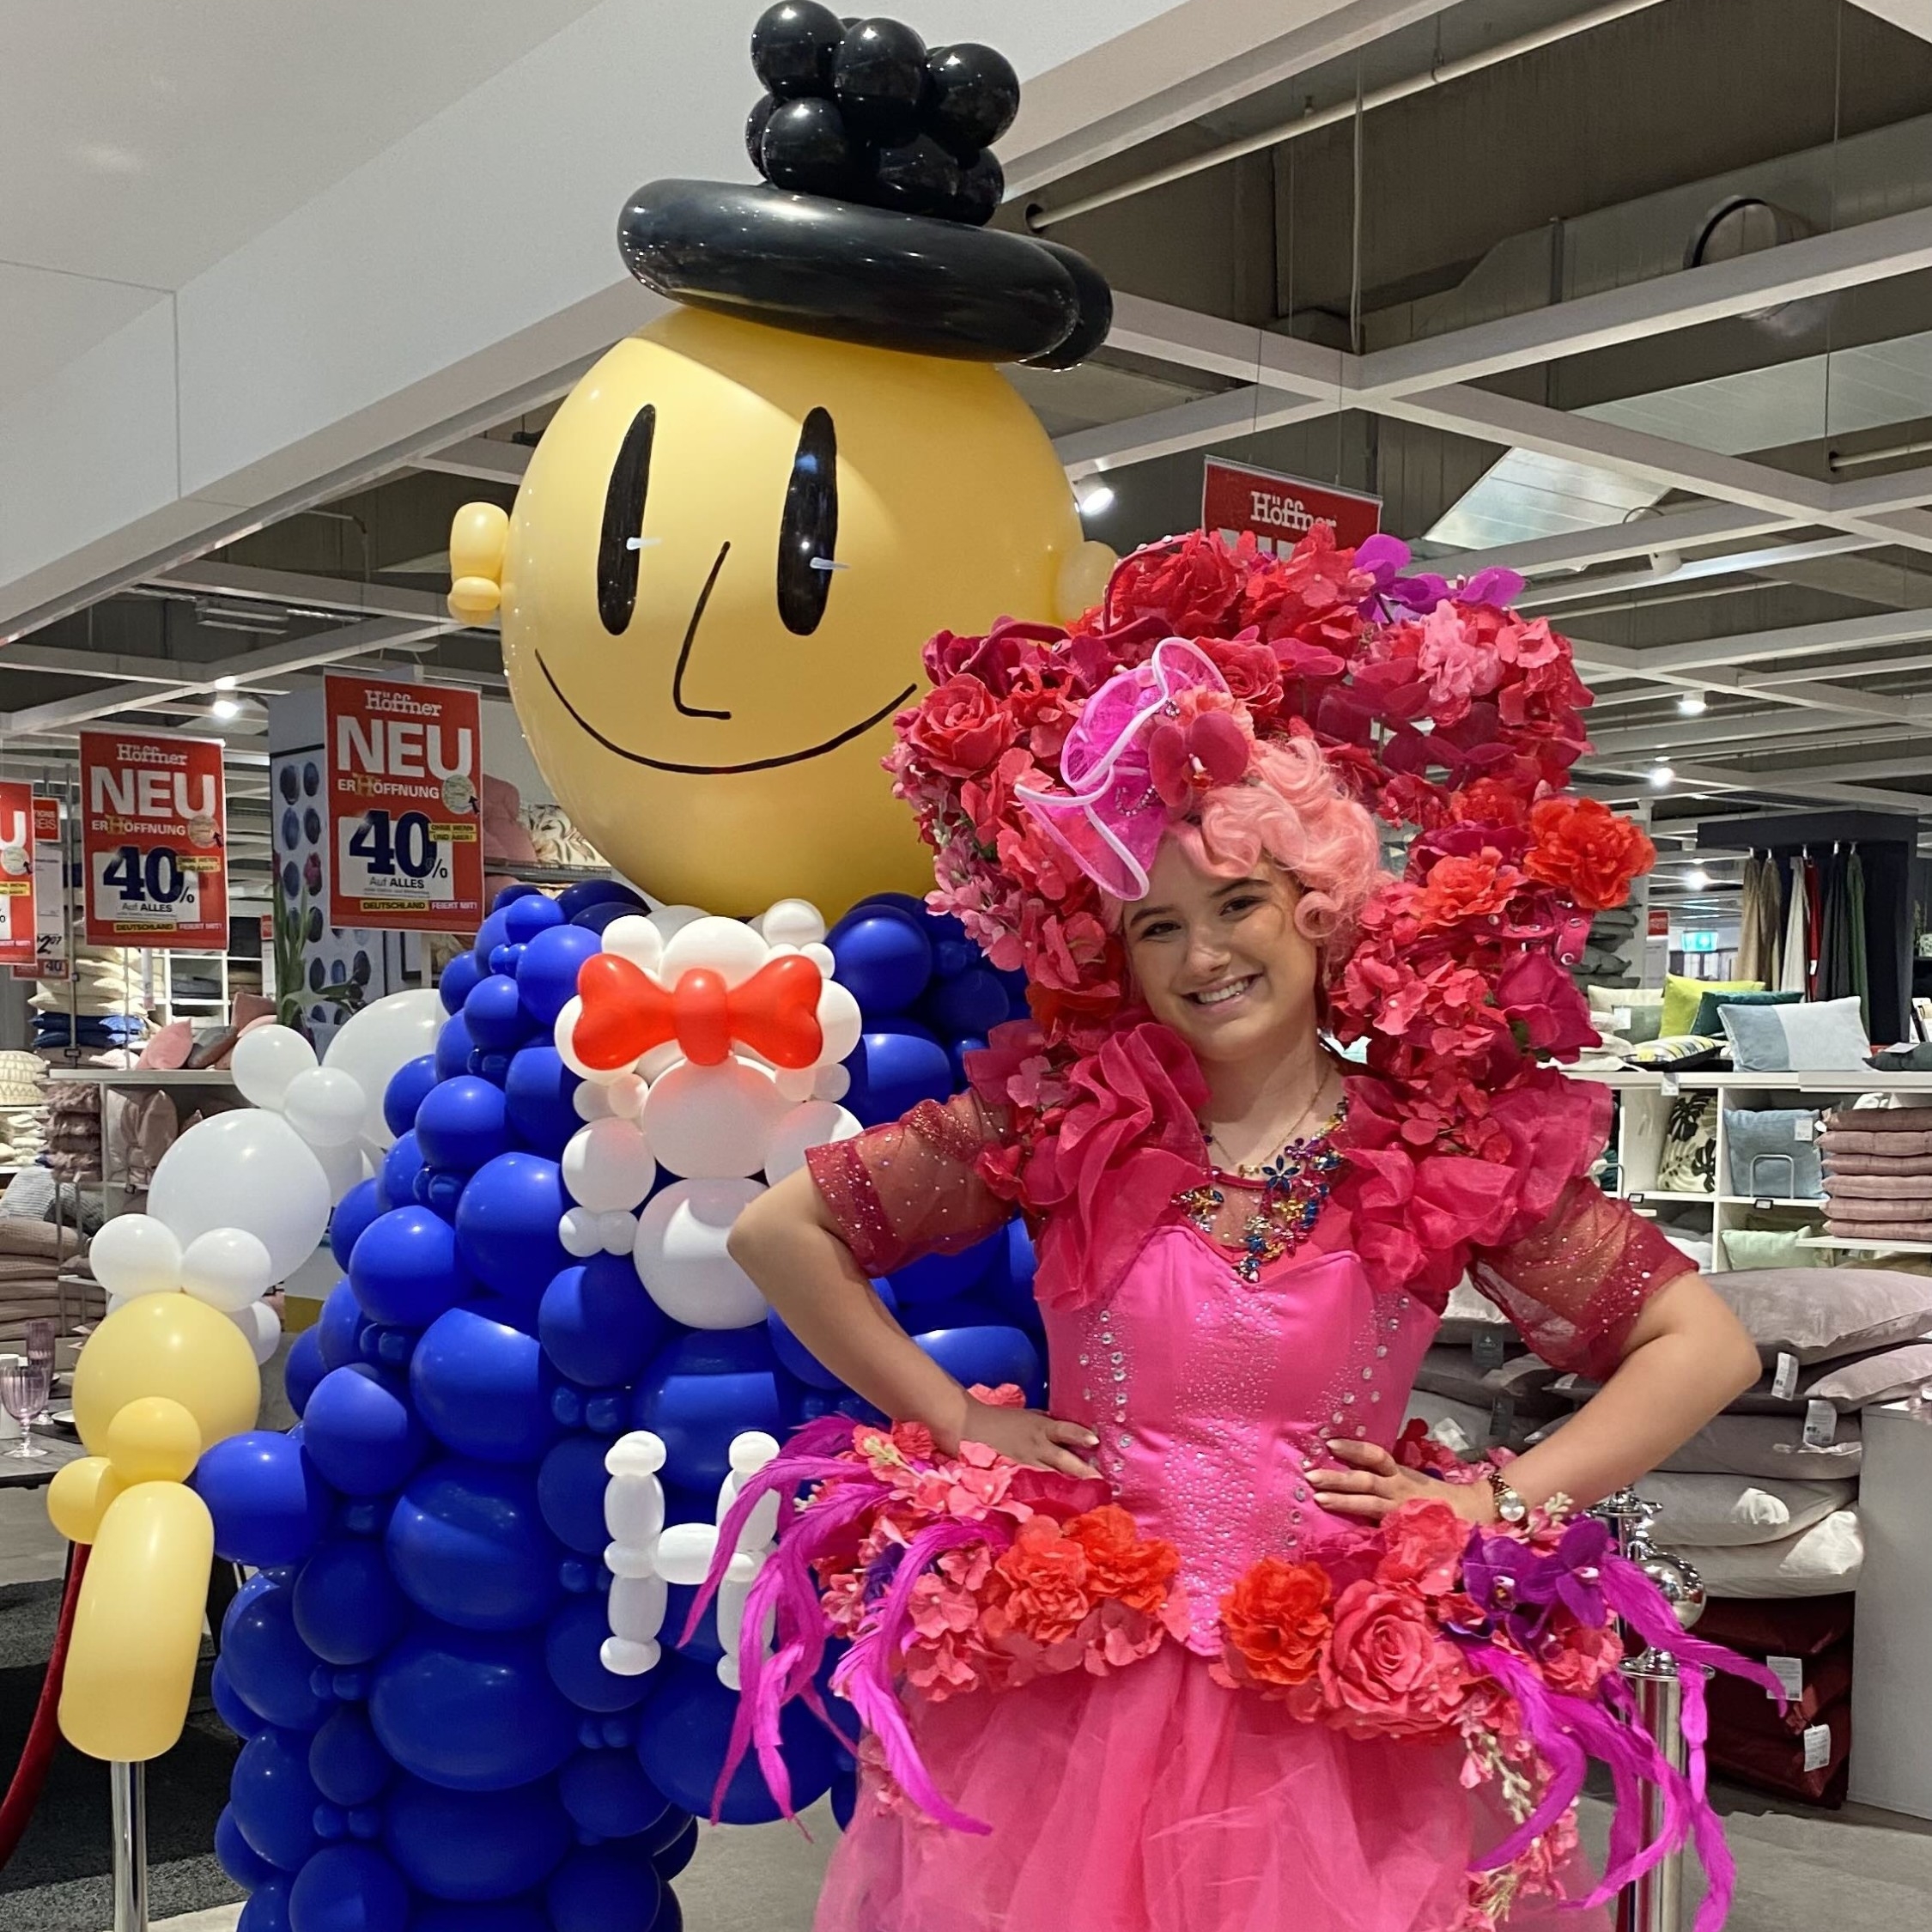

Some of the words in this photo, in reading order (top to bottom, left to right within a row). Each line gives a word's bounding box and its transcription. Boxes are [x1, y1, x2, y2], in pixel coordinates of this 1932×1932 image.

[365, 690, 442, 716] Höffner
[116, 744, 188, 766] Höffner
[337, 714, 472, 781] NEU
[90, 765, 216, 820] NEU
[369, 877, 386, 886] Auf
[389, 878, 425, 889] ALLES
[140, 904, 173, 913] ALLES
[363, 902, 425, 910] DEUTSCHLAND
[432, 902, 458, 910] FEIERT
